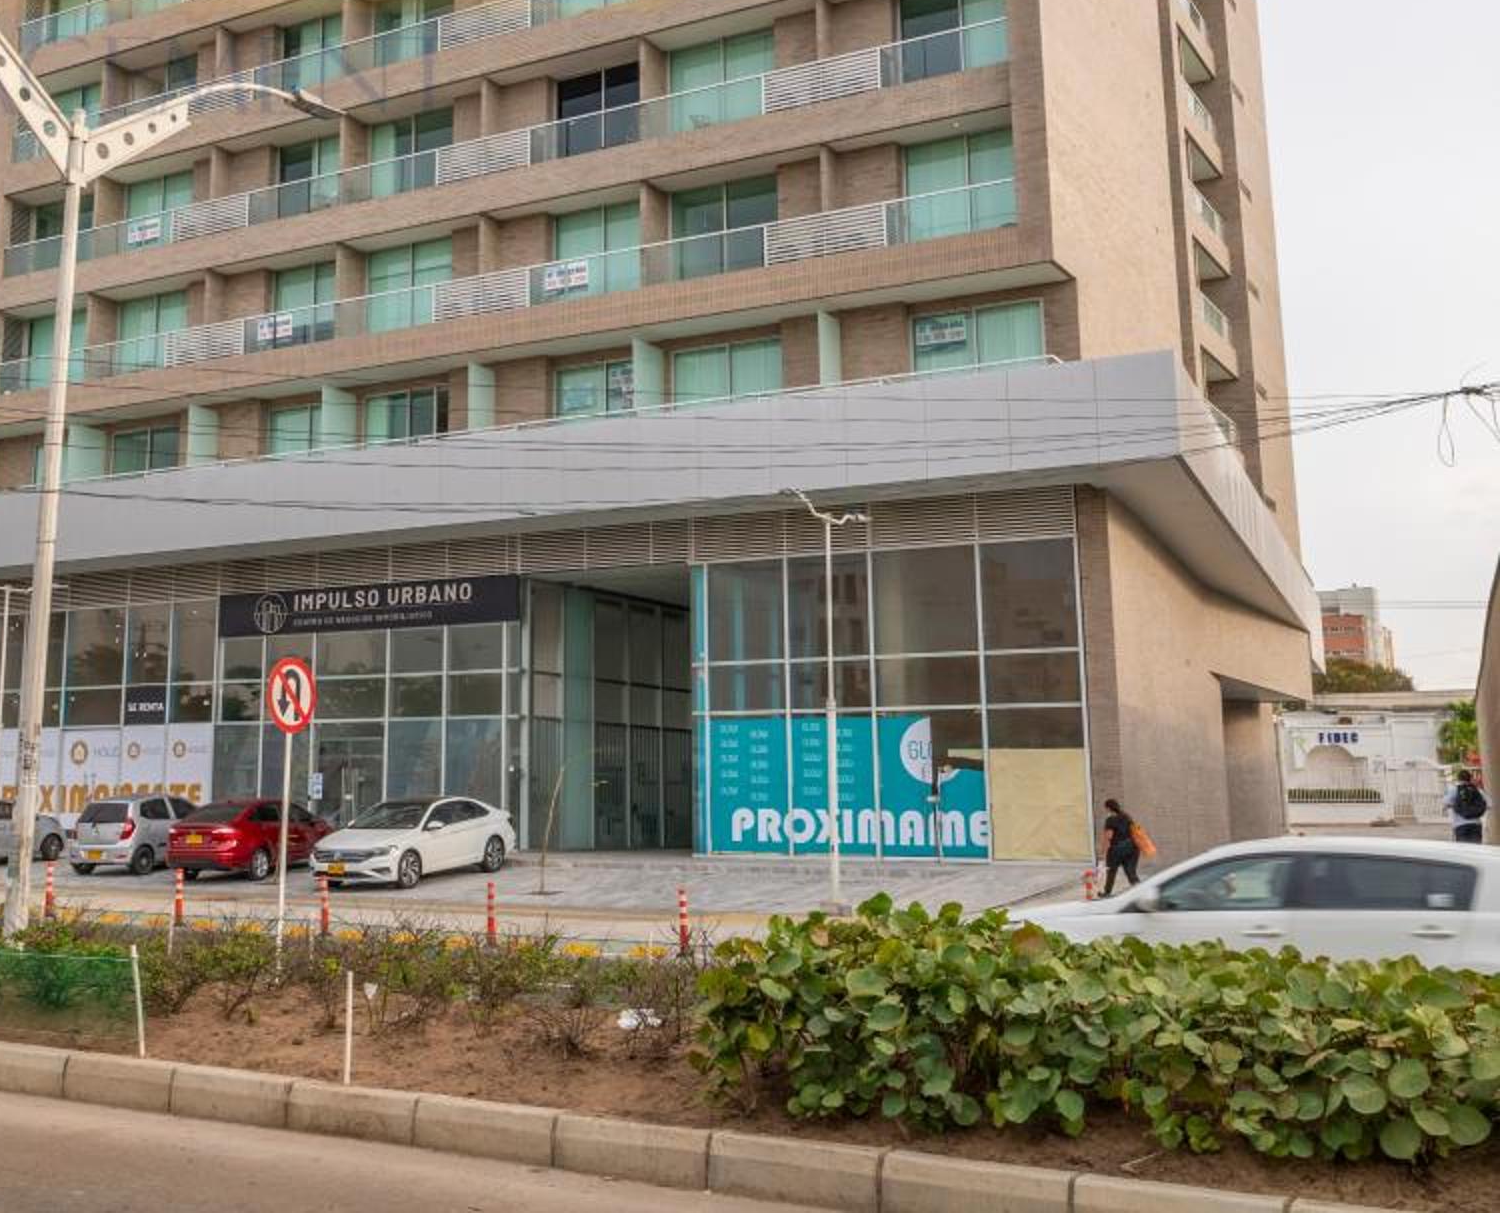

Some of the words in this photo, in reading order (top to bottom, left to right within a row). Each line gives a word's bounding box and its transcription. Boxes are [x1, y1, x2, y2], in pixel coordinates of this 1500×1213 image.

[293, 590, 380, 612] IMPULSO
[387, 583, 473, 605] URBANO
[128, 703, 137, 712] SE
[138, 702, 165, 712] RENTA
